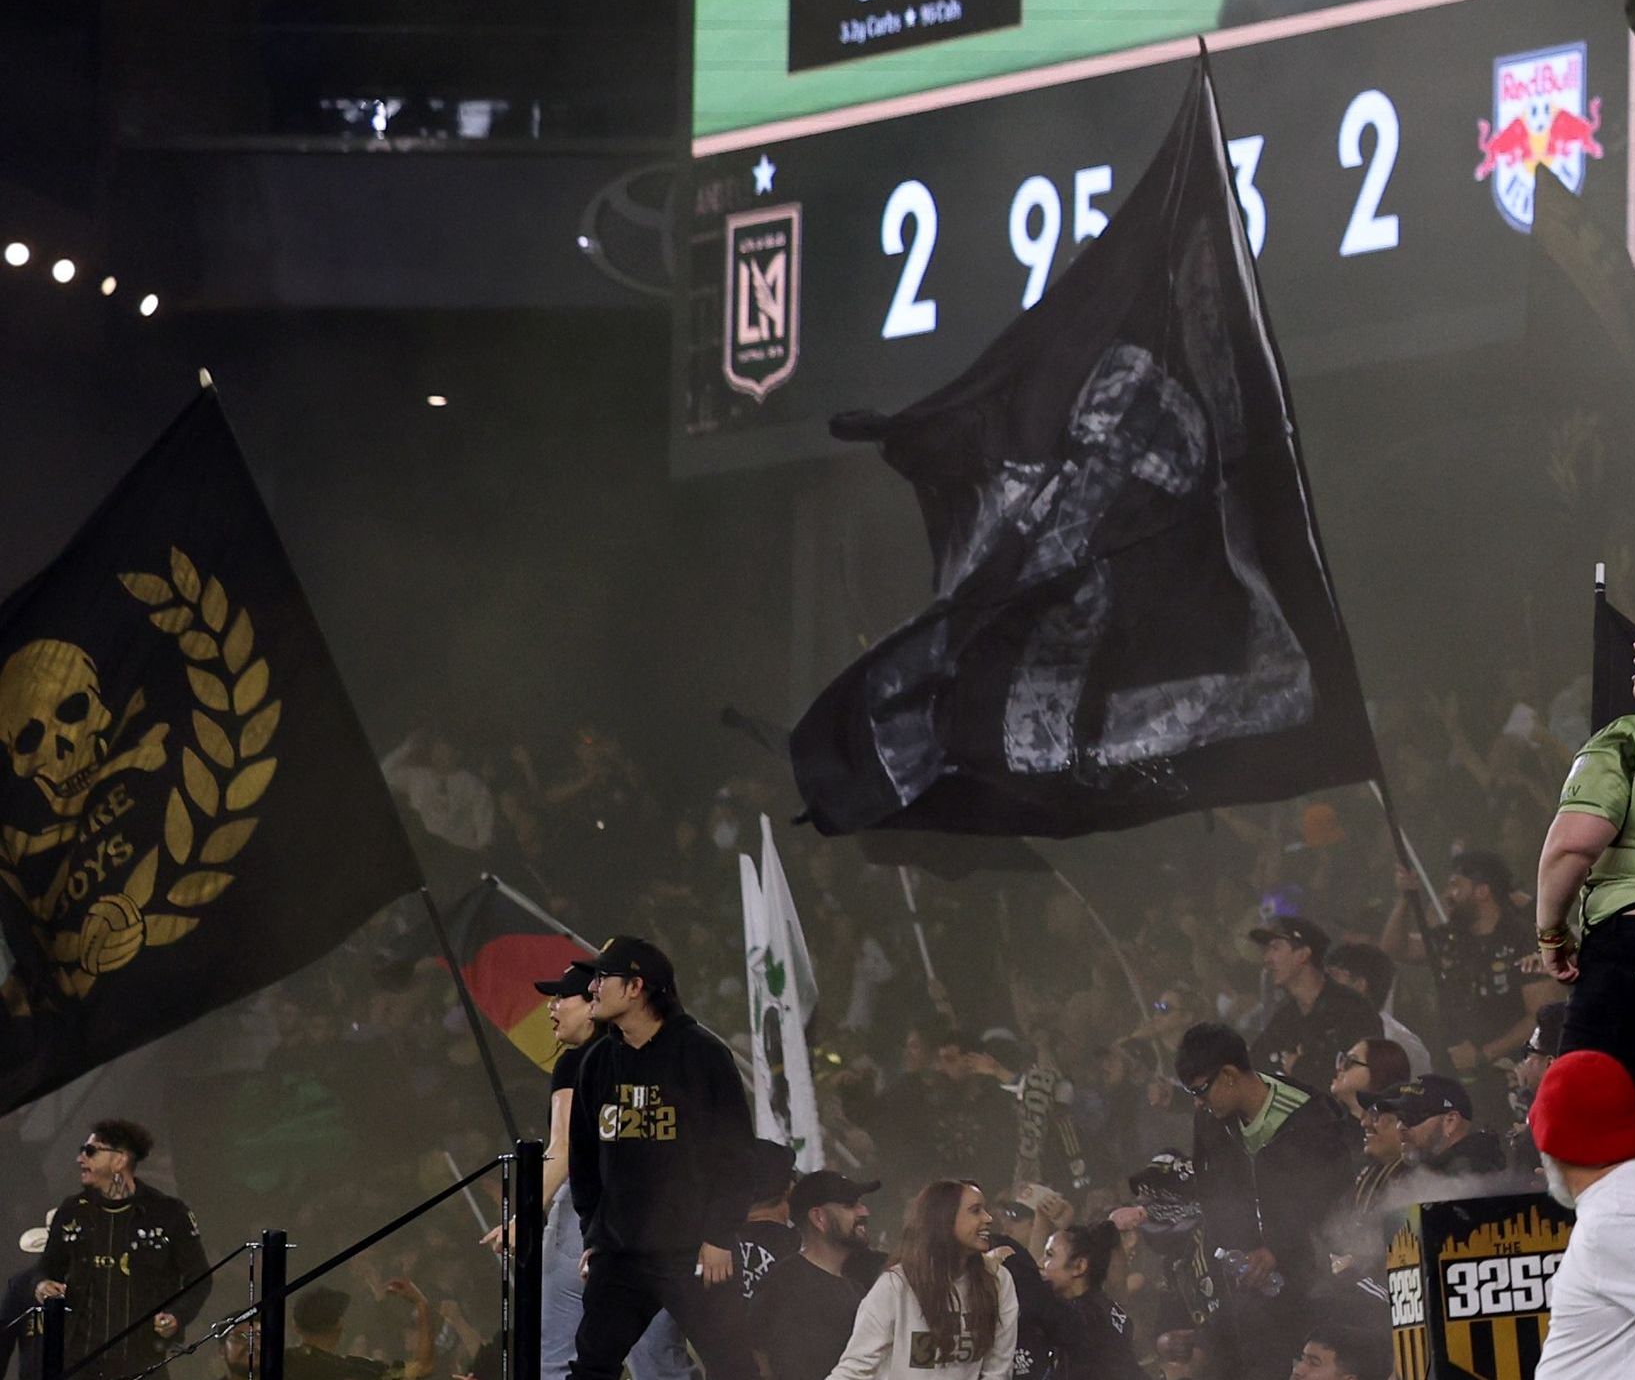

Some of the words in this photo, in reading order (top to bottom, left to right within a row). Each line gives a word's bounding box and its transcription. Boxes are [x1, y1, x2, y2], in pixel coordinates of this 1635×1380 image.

[881, 180, 938, 339] 2
[1339, 89, 1400, 258] 2
[617, 1083, 665, 1107] THE
[1494, 1241, 1521, 1255] THE
[1388, 1267, 1425, 1328] 3252
